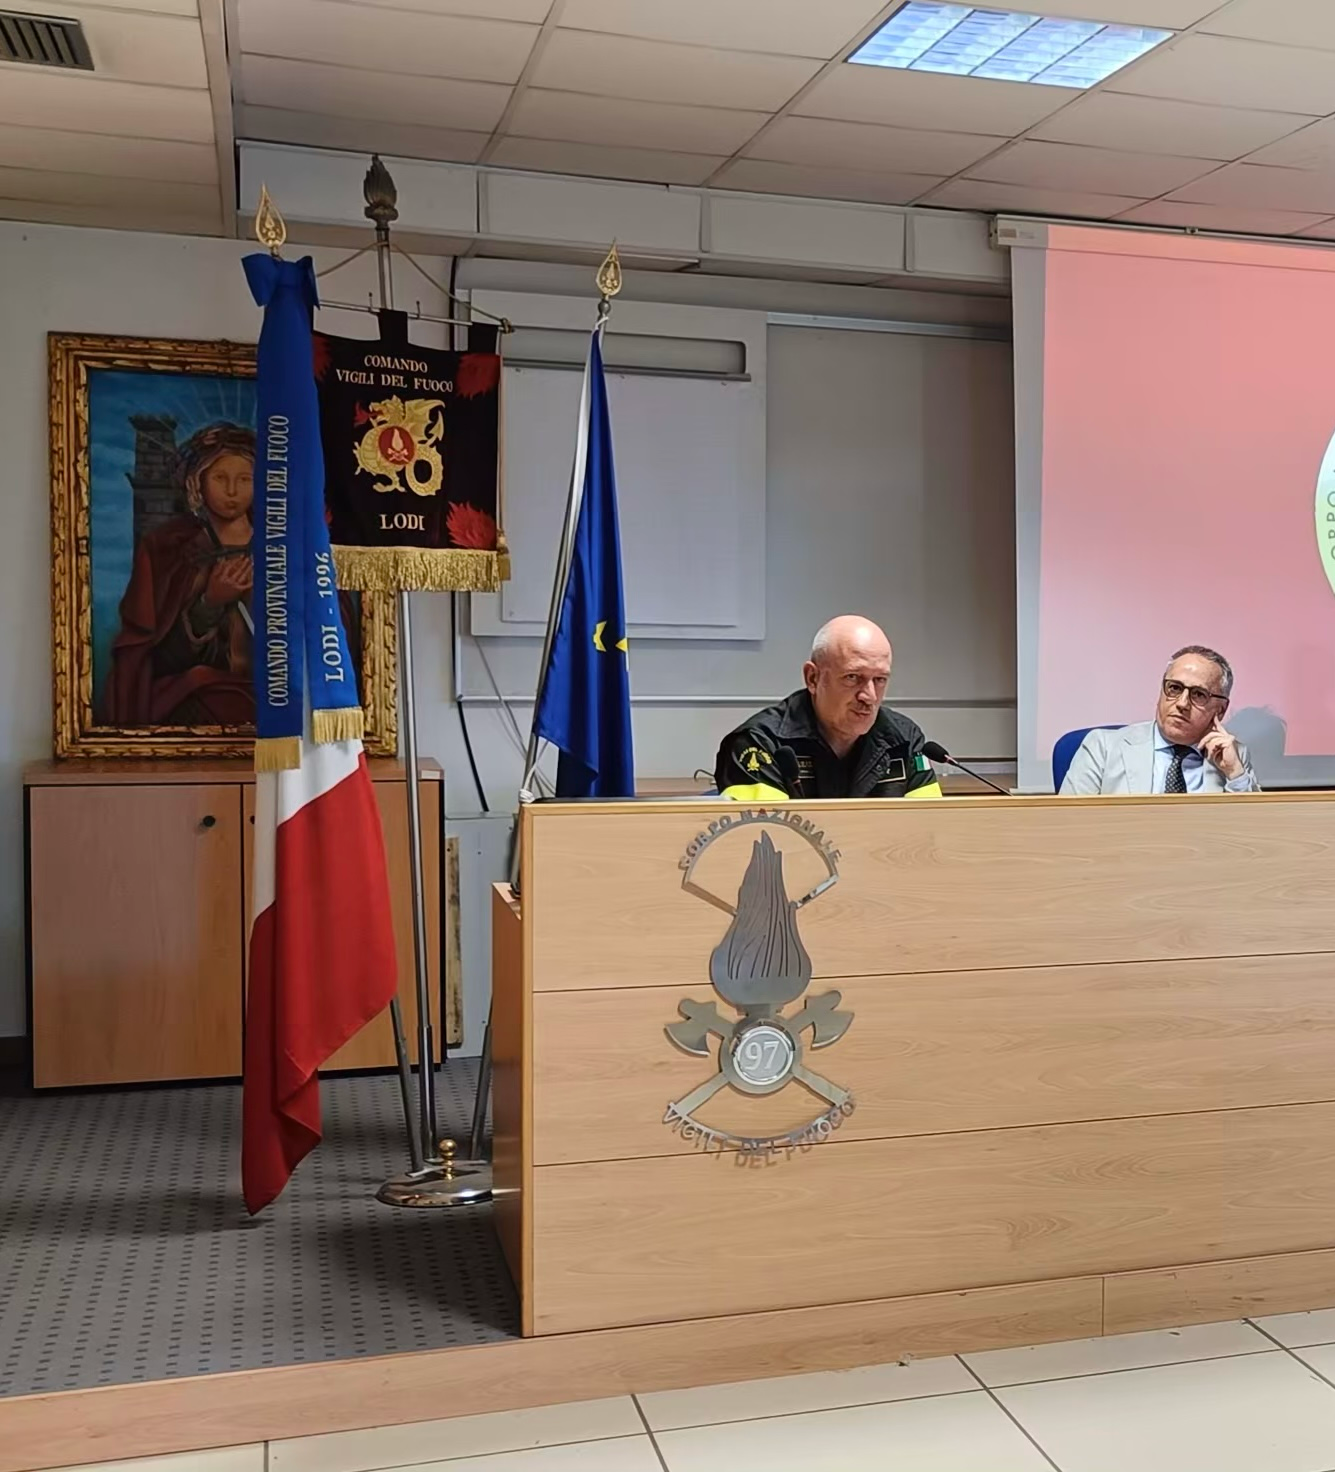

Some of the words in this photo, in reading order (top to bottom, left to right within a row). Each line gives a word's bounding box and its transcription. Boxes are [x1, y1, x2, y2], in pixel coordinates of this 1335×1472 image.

[336, 369, 374, 385] VIGILI
[381, 374, 407, 388] DEL
[414, 378, 453, 392] FUOCO
[364, 355, 428, 373] COMANDO
[267, 415, 289, 462] FUOCO
[267, 467, 288, 493] DEL
[266, 497, 287, 539] VIGILI
[380, 513, 425, 530] LODI
[266, 544, 287, 635] PROVINCIALE
[315, 552, 333, 598] 1996
[267, 639, 289, 706] COMANDO
[321, 625, 344, 682] LODI
[677, 815, 732, 872] CORPO
[740, 808, 842, 863] NAZIONALE
[745, 1040, 780, 1070] 97
